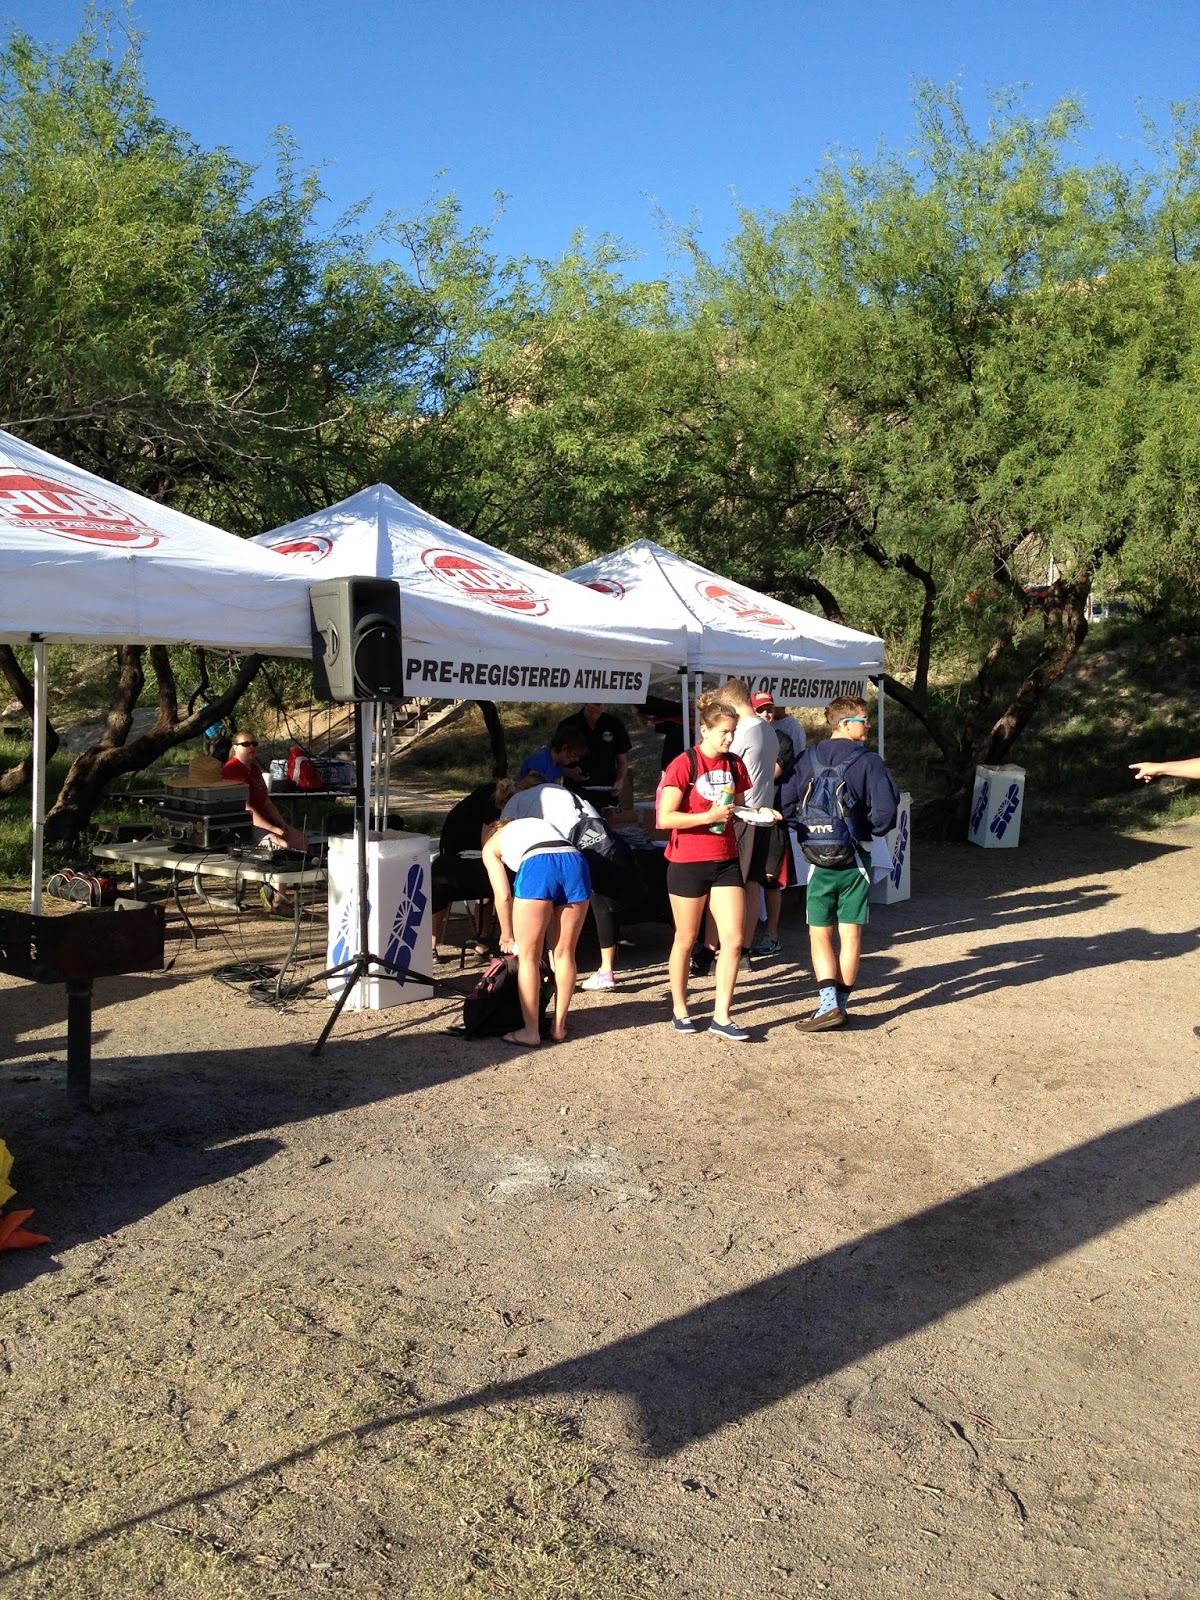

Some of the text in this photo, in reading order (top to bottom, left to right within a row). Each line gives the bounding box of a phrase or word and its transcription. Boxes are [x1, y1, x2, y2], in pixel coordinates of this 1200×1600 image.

[0, 490, 130, 520] HUB
[435, 568, 524, 590] HUB
[406, 658, 643, 690] PRE-REGISTERED ATHLETES
[758, 676, 779, 694] OF
[780, 677, 865, 698] REGISTRATION
[990, 783, 1020, 840] SRP
[578, 834, 607, 849] didas
[817, 824, 834, 833] TYR
[384, 864, 427, 987] SRP
